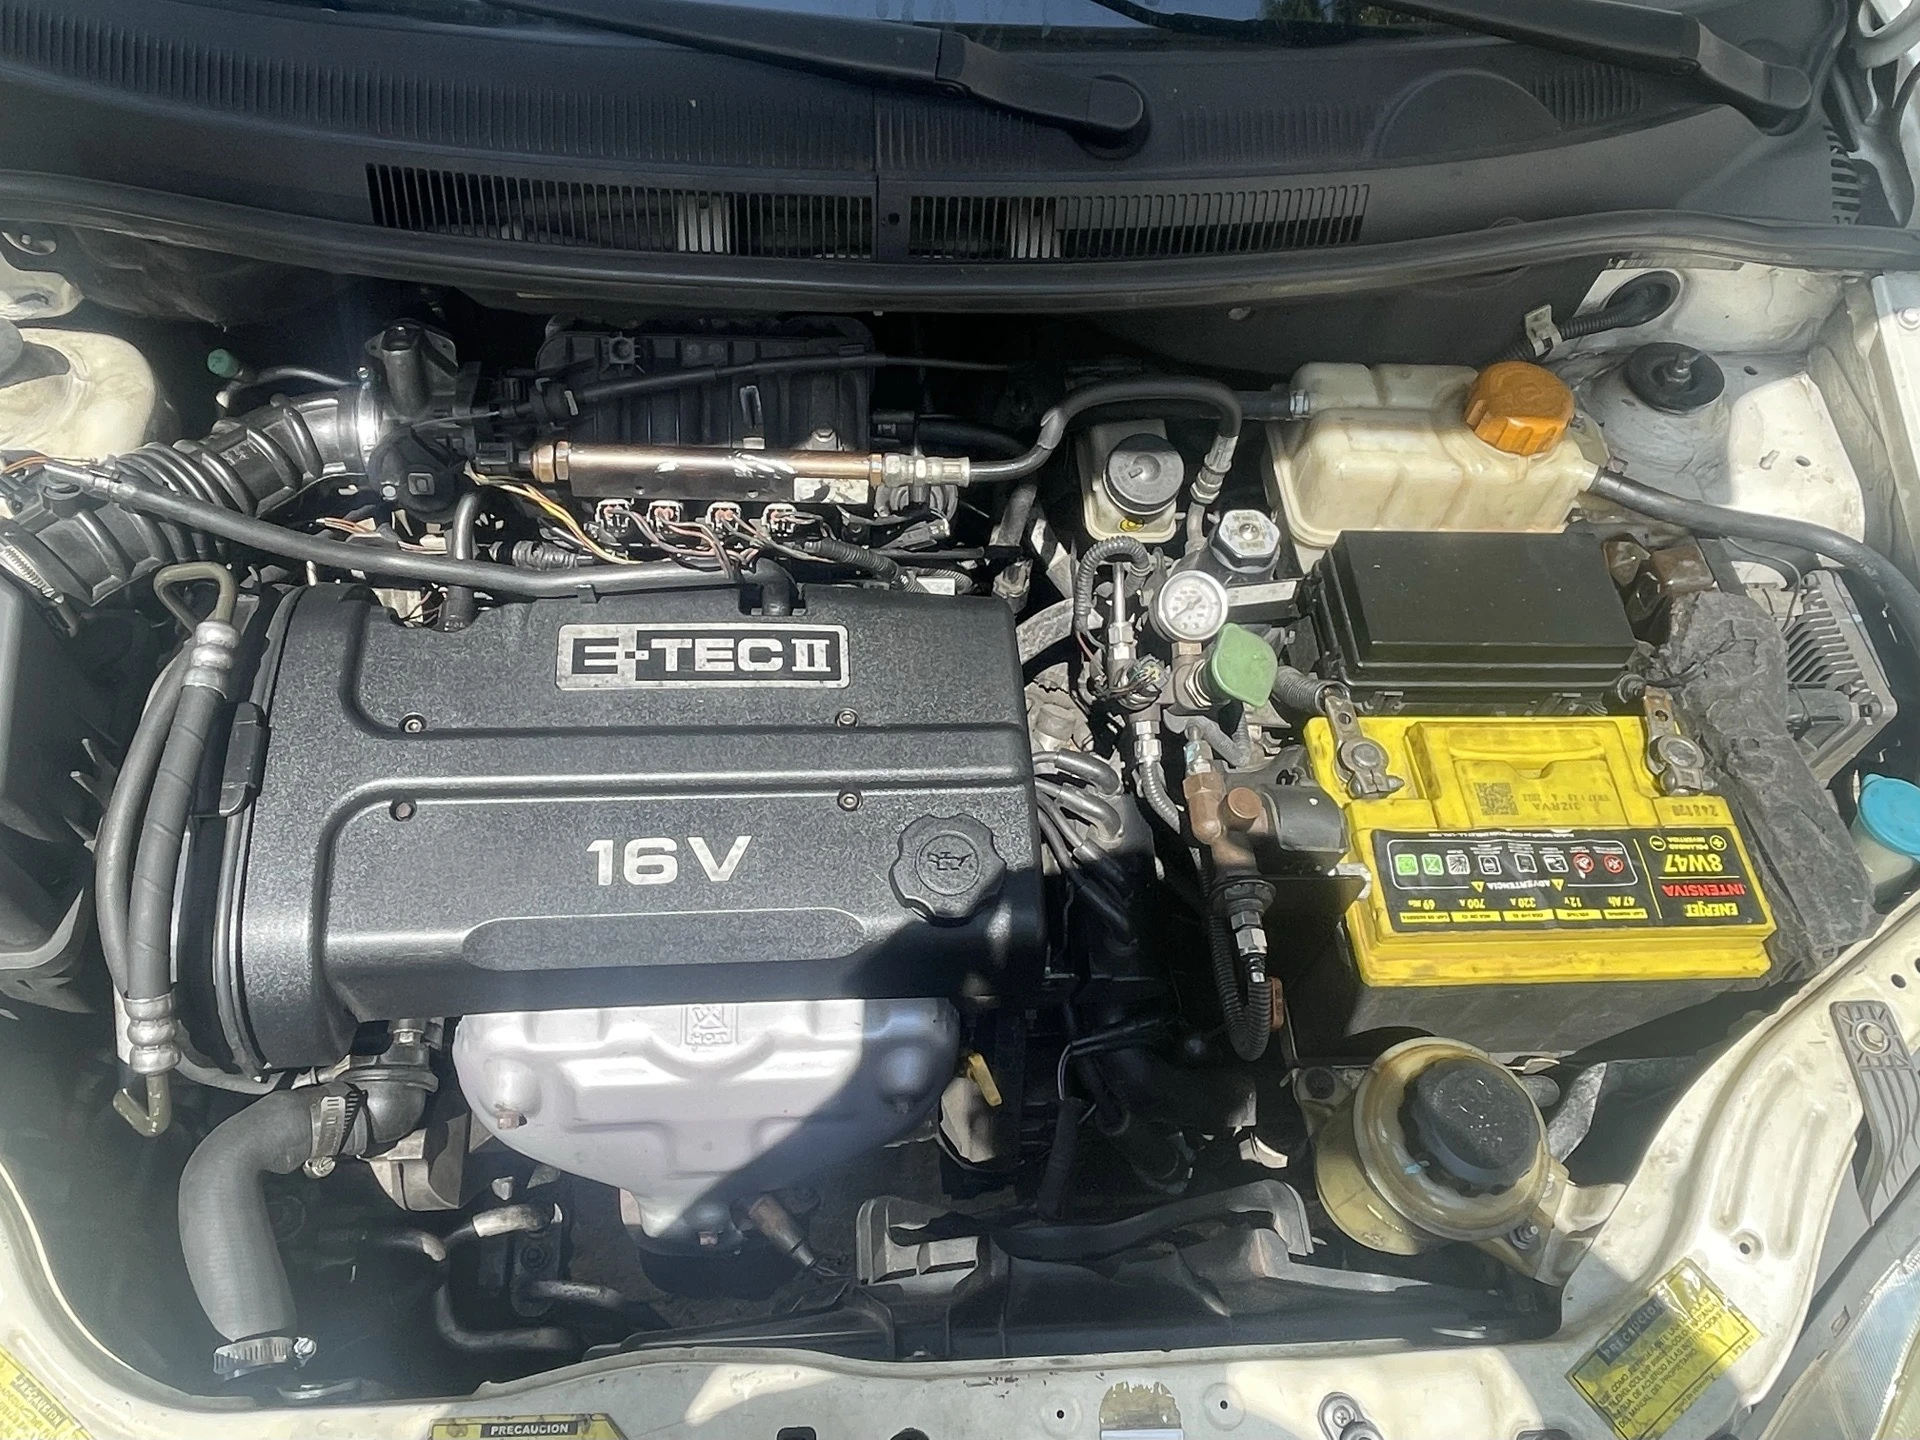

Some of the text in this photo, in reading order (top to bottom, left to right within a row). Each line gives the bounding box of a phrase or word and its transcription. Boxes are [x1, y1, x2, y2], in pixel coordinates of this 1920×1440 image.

[790, 638, 832, 673] II
[586, 835, 752, 886] 16V
[1664, 853, 1722, 872] 8W47
[1486, 879, 1550, 889] ADVERTENCIA
[1661, 883, 1744, 896] INTENSIVA
[1423, 899, 1434, 909] 69
[1467, 897, 1485, 909] 700
[1517, 896, 1536, 907] 320
[1607, 895, 1634, 906] 47 Ah
[1685, 899, 1738, 915] ENERJET
[1609, 1373, 1630, 1393] COMO
[15, 1378, 63, 1426] PRECAUCION
[1627, 1393, 1652, 1417] MANUAL
[1649, 1382, 1663, 1395] DEL
[490, 1423, 569, 1436] PRECAUCION
